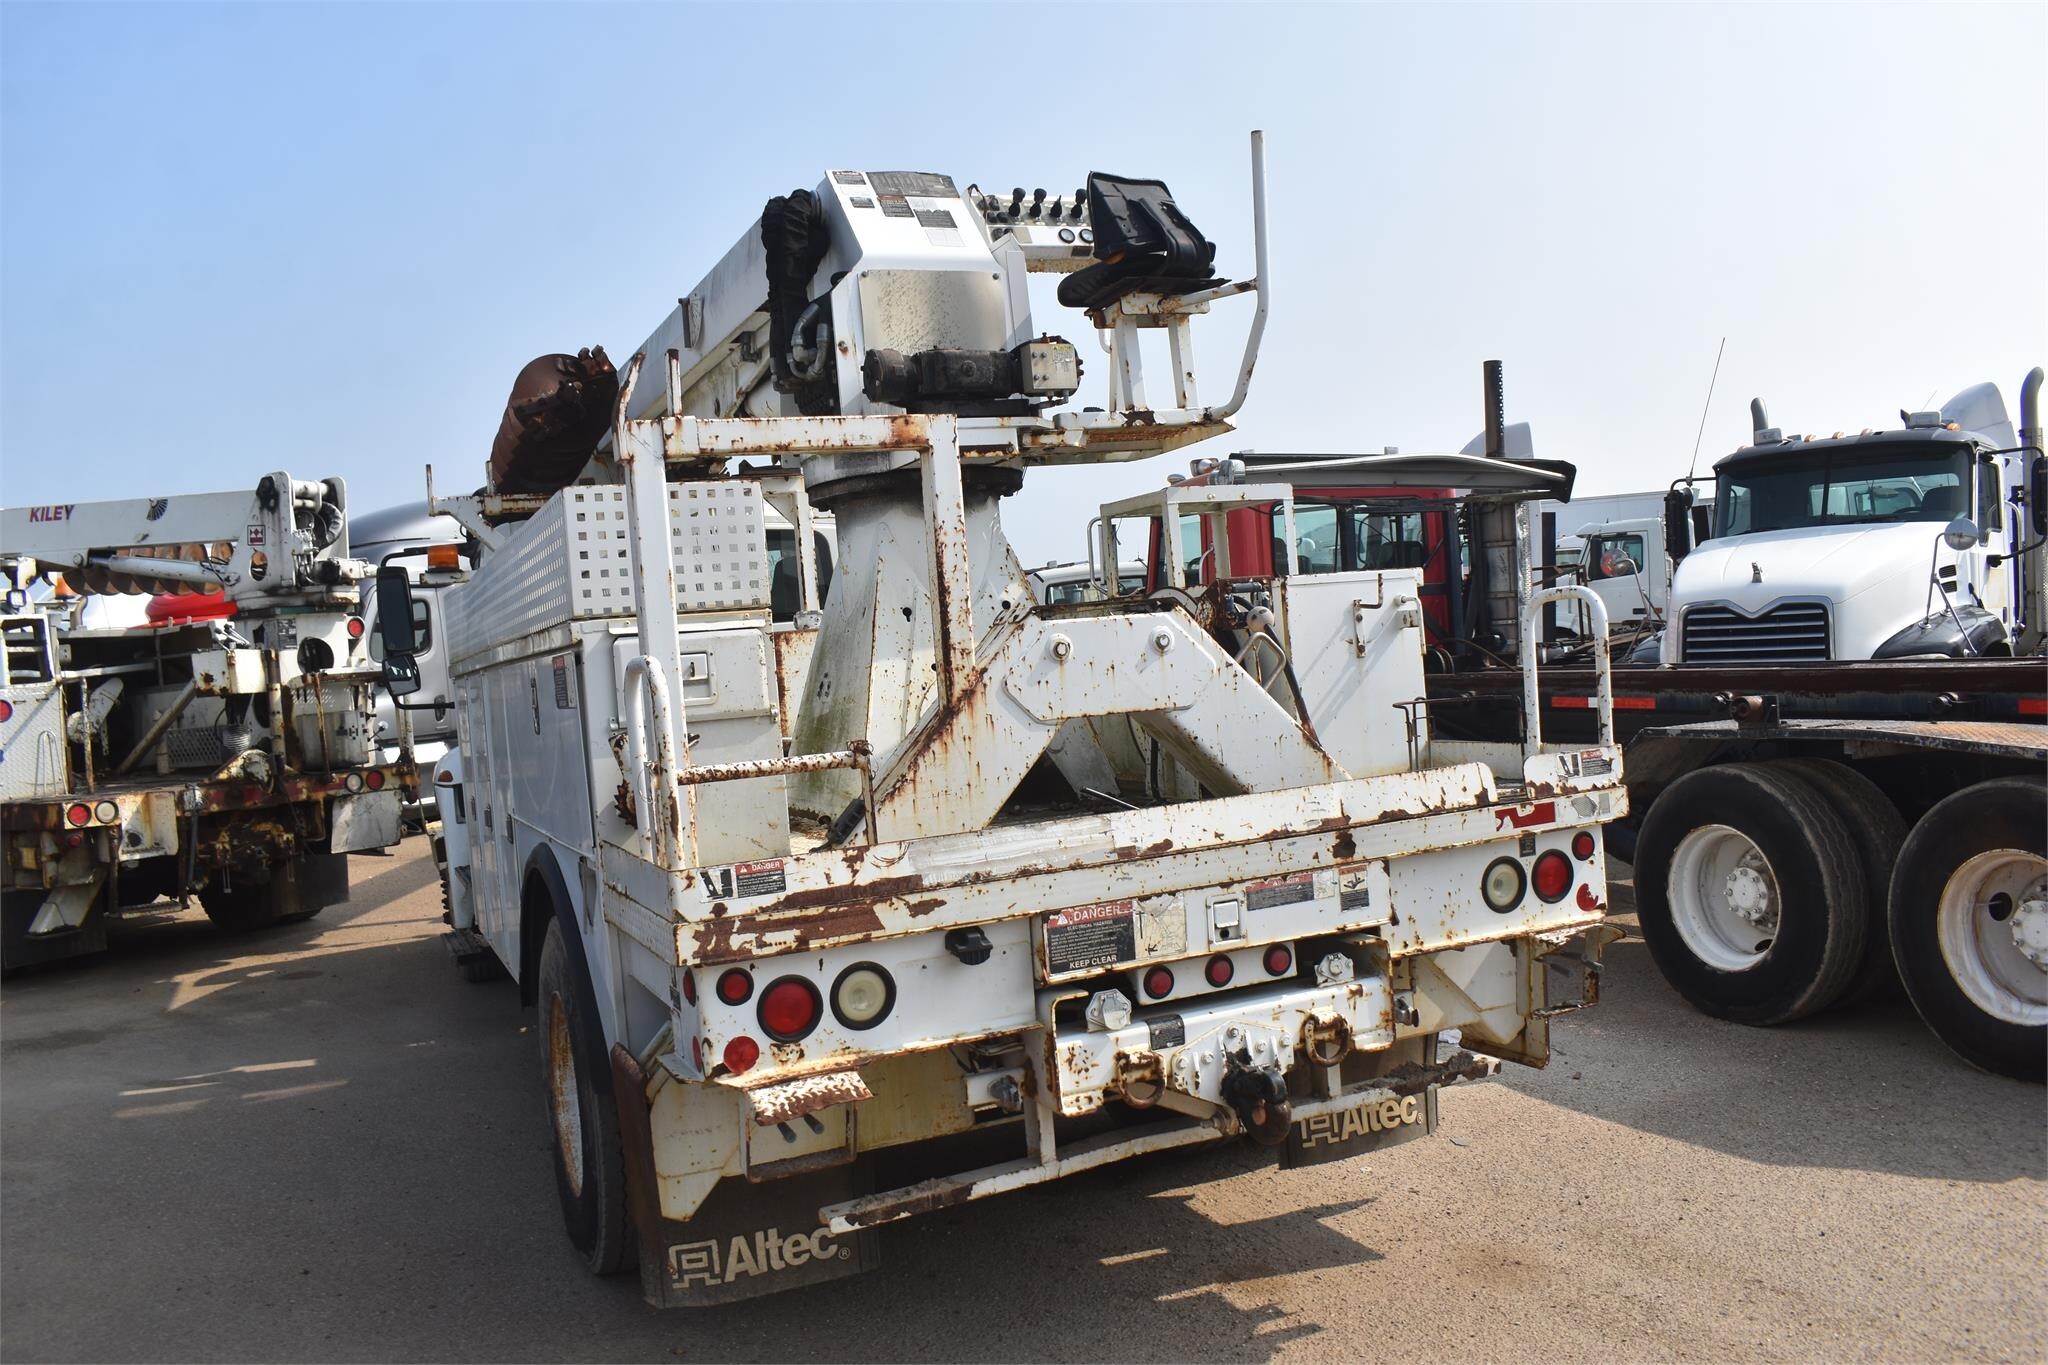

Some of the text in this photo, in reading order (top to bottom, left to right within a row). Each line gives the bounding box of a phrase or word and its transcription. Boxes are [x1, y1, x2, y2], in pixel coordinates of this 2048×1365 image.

[29, 504, 76, 523] KILEY
[751, 861, 781, 872] DANGER
[1073, 905, 1120, 921] DANGER
[1069, 954, 1117, 969] KEEP CLEAR
[1341, 1095, 1418, 1140] Altec
[724, 1227, 839, 1283] Altec
